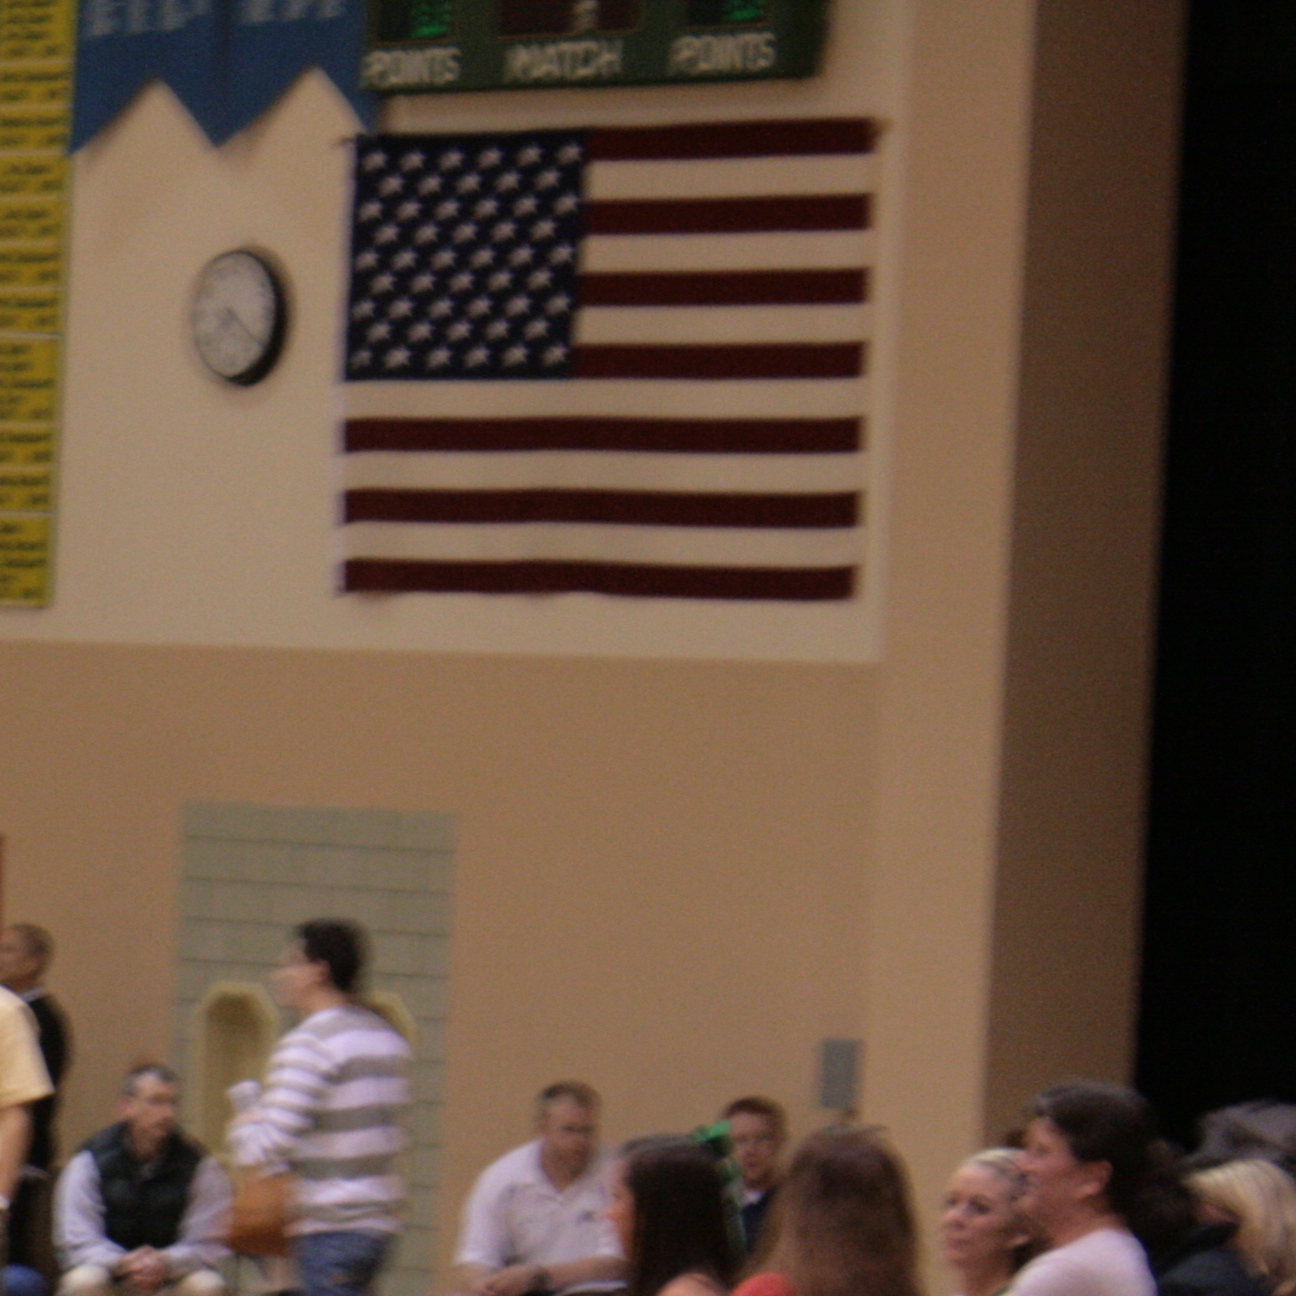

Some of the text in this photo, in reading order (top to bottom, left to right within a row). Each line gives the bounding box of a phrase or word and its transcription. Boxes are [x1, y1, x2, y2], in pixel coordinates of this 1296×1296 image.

[362, 47, 462, 90] POINTS
[504, 39, 625, 84] MATCH
[667, 32, 778, 78] POINTS
